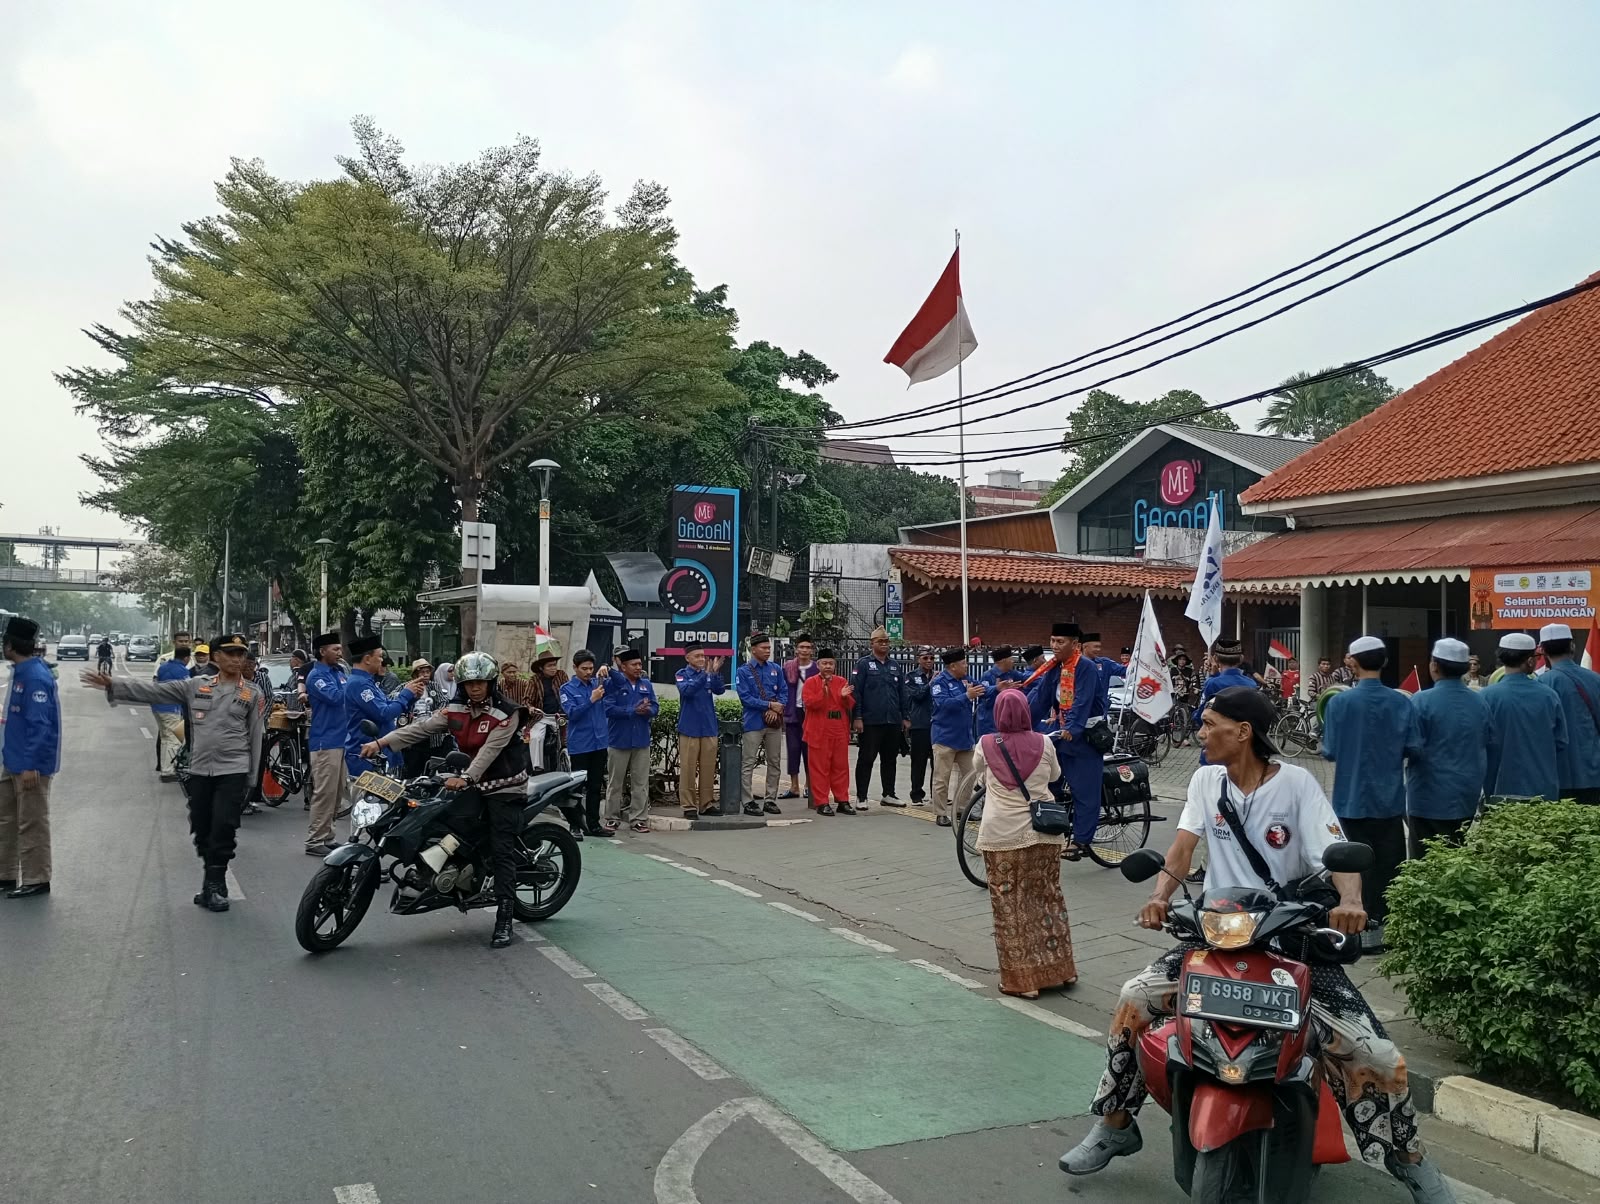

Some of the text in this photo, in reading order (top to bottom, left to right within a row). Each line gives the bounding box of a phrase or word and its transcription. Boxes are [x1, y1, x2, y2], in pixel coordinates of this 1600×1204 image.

[678, 516, 731, 540] GACOAN
[888, 585, 896, 598] P
[1504, 595, 1588, 607] Selamat Datang
[1497, 608, 1596, 618] TAMU UNDANGAN
[1191, 979, 1292, 1008] B 6958 VKT
